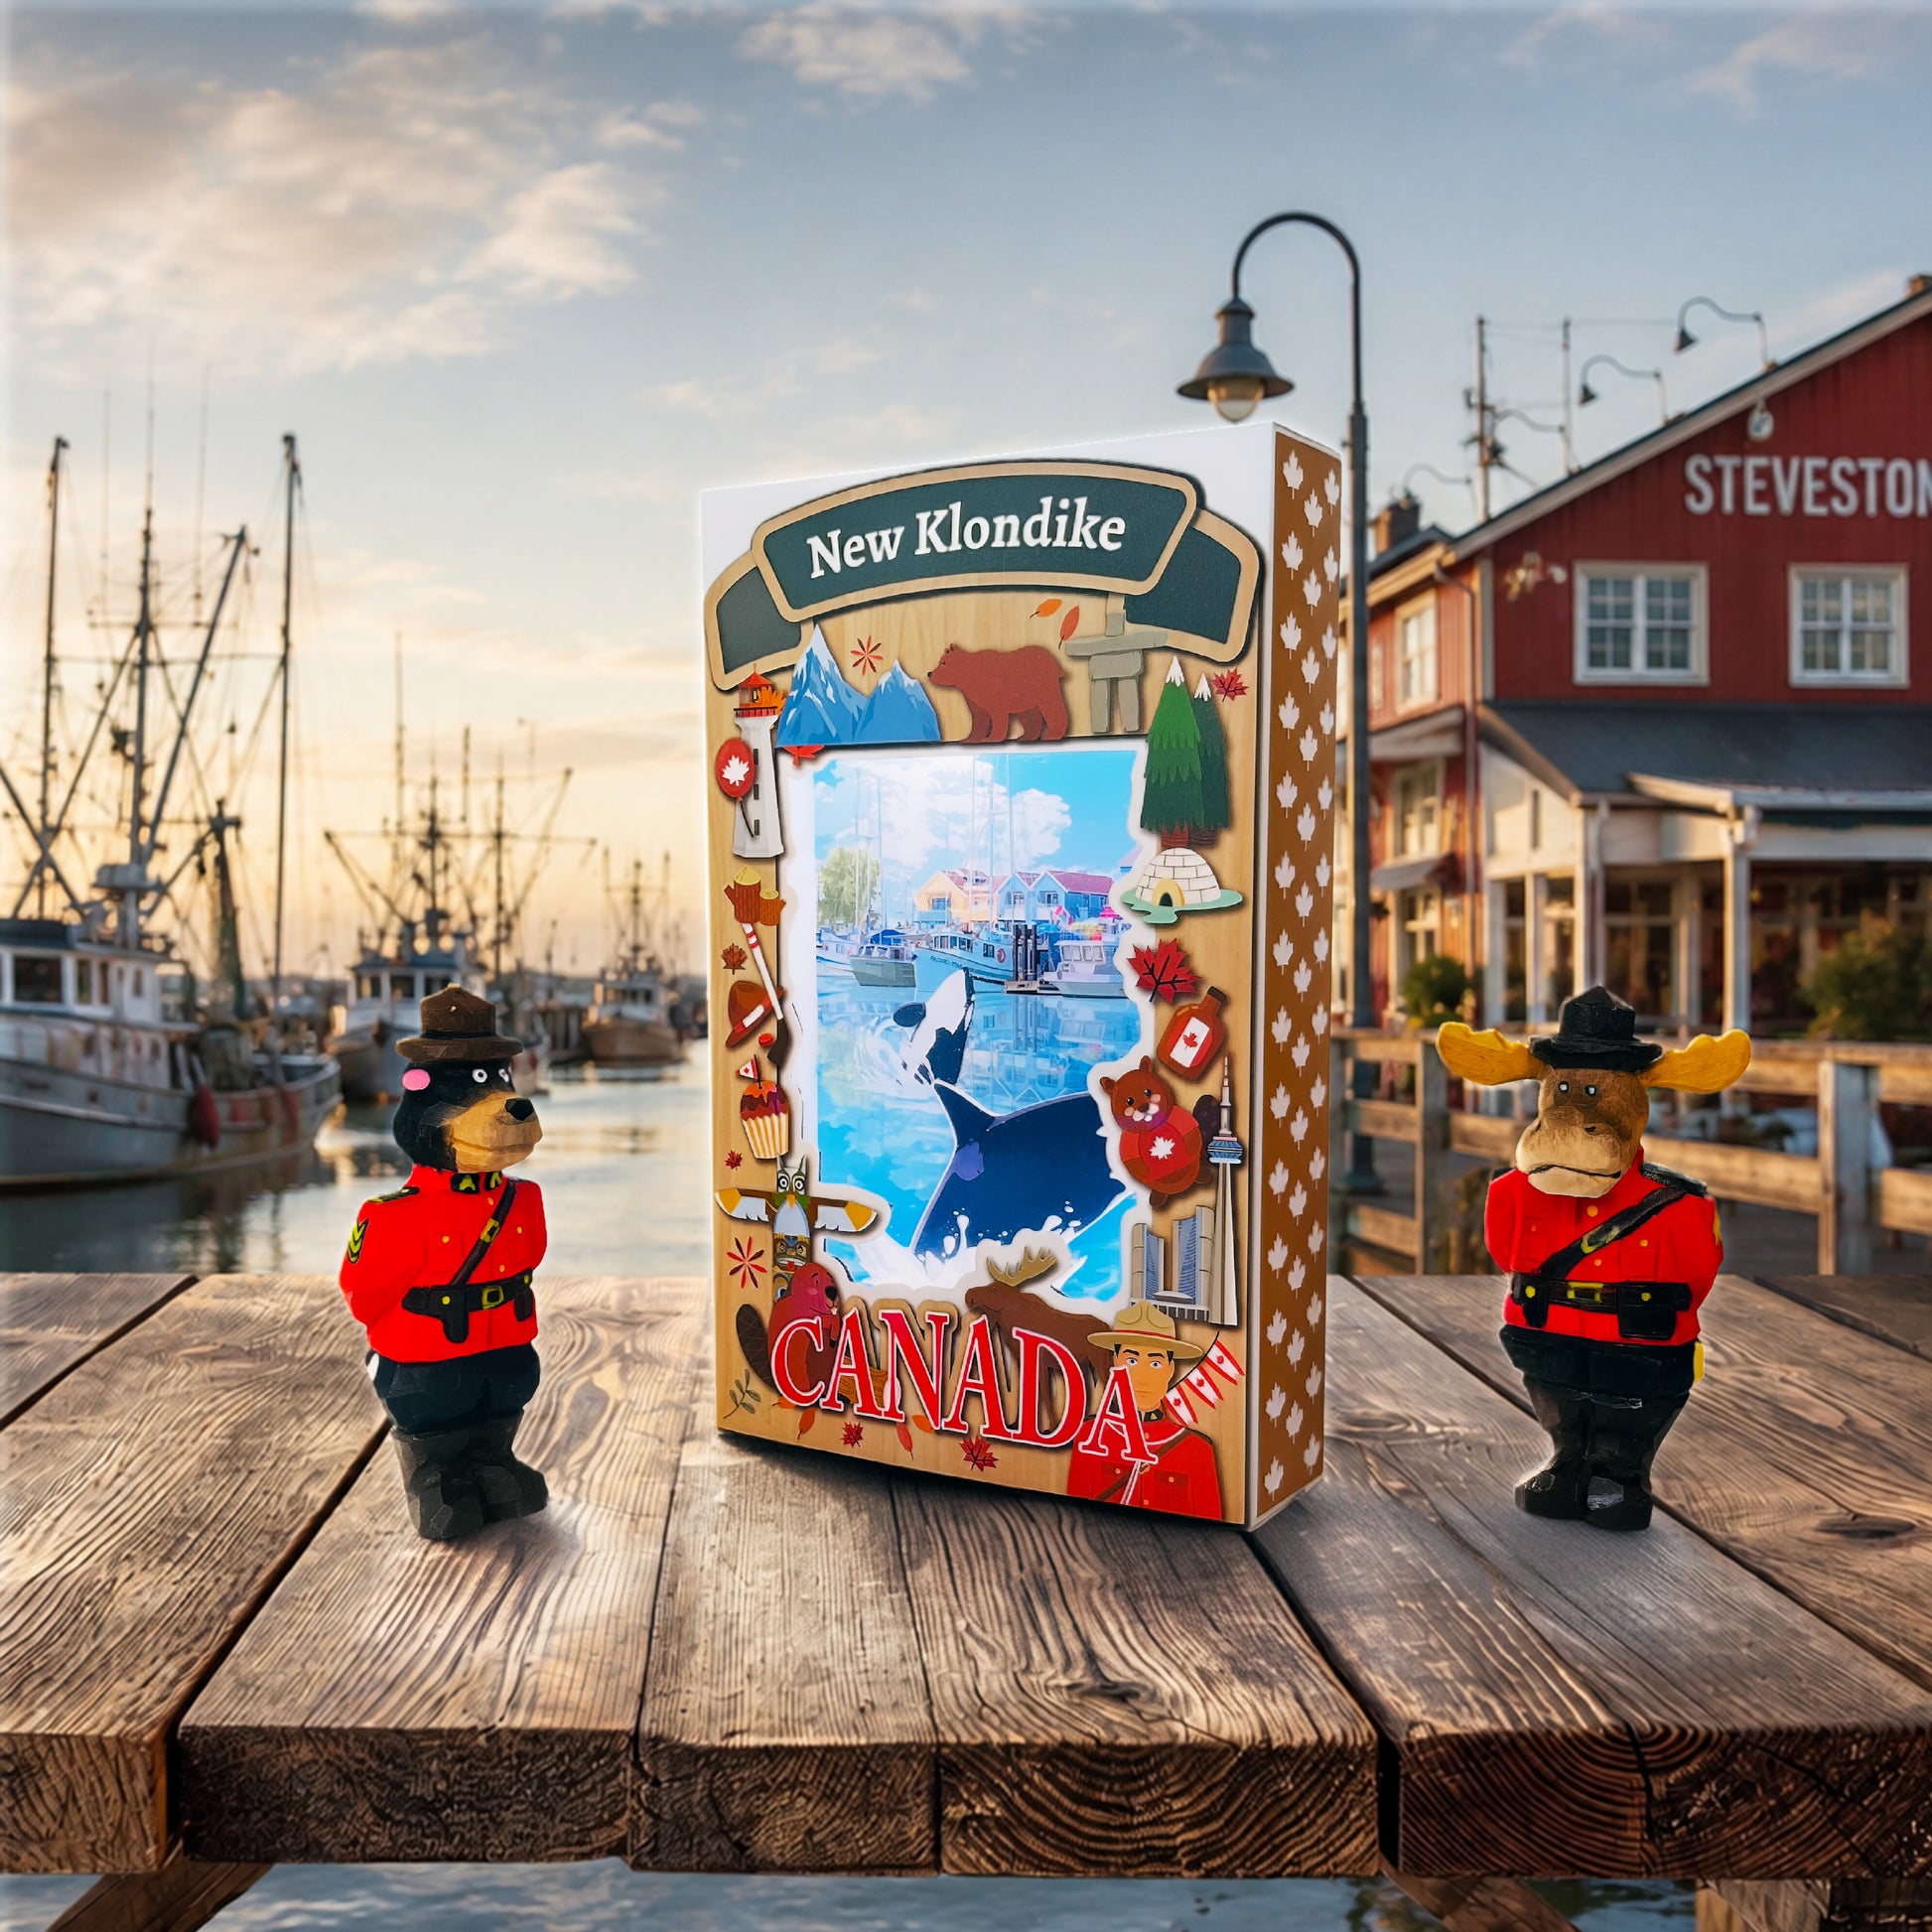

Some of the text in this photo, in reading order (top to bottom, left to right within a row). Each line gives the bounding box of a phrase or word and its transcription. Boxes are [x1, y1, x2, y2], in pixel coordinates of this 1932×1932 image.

[806, 495, 1126, 579] New Klondike
[771, 1307, 1158, 1464] CANADA
